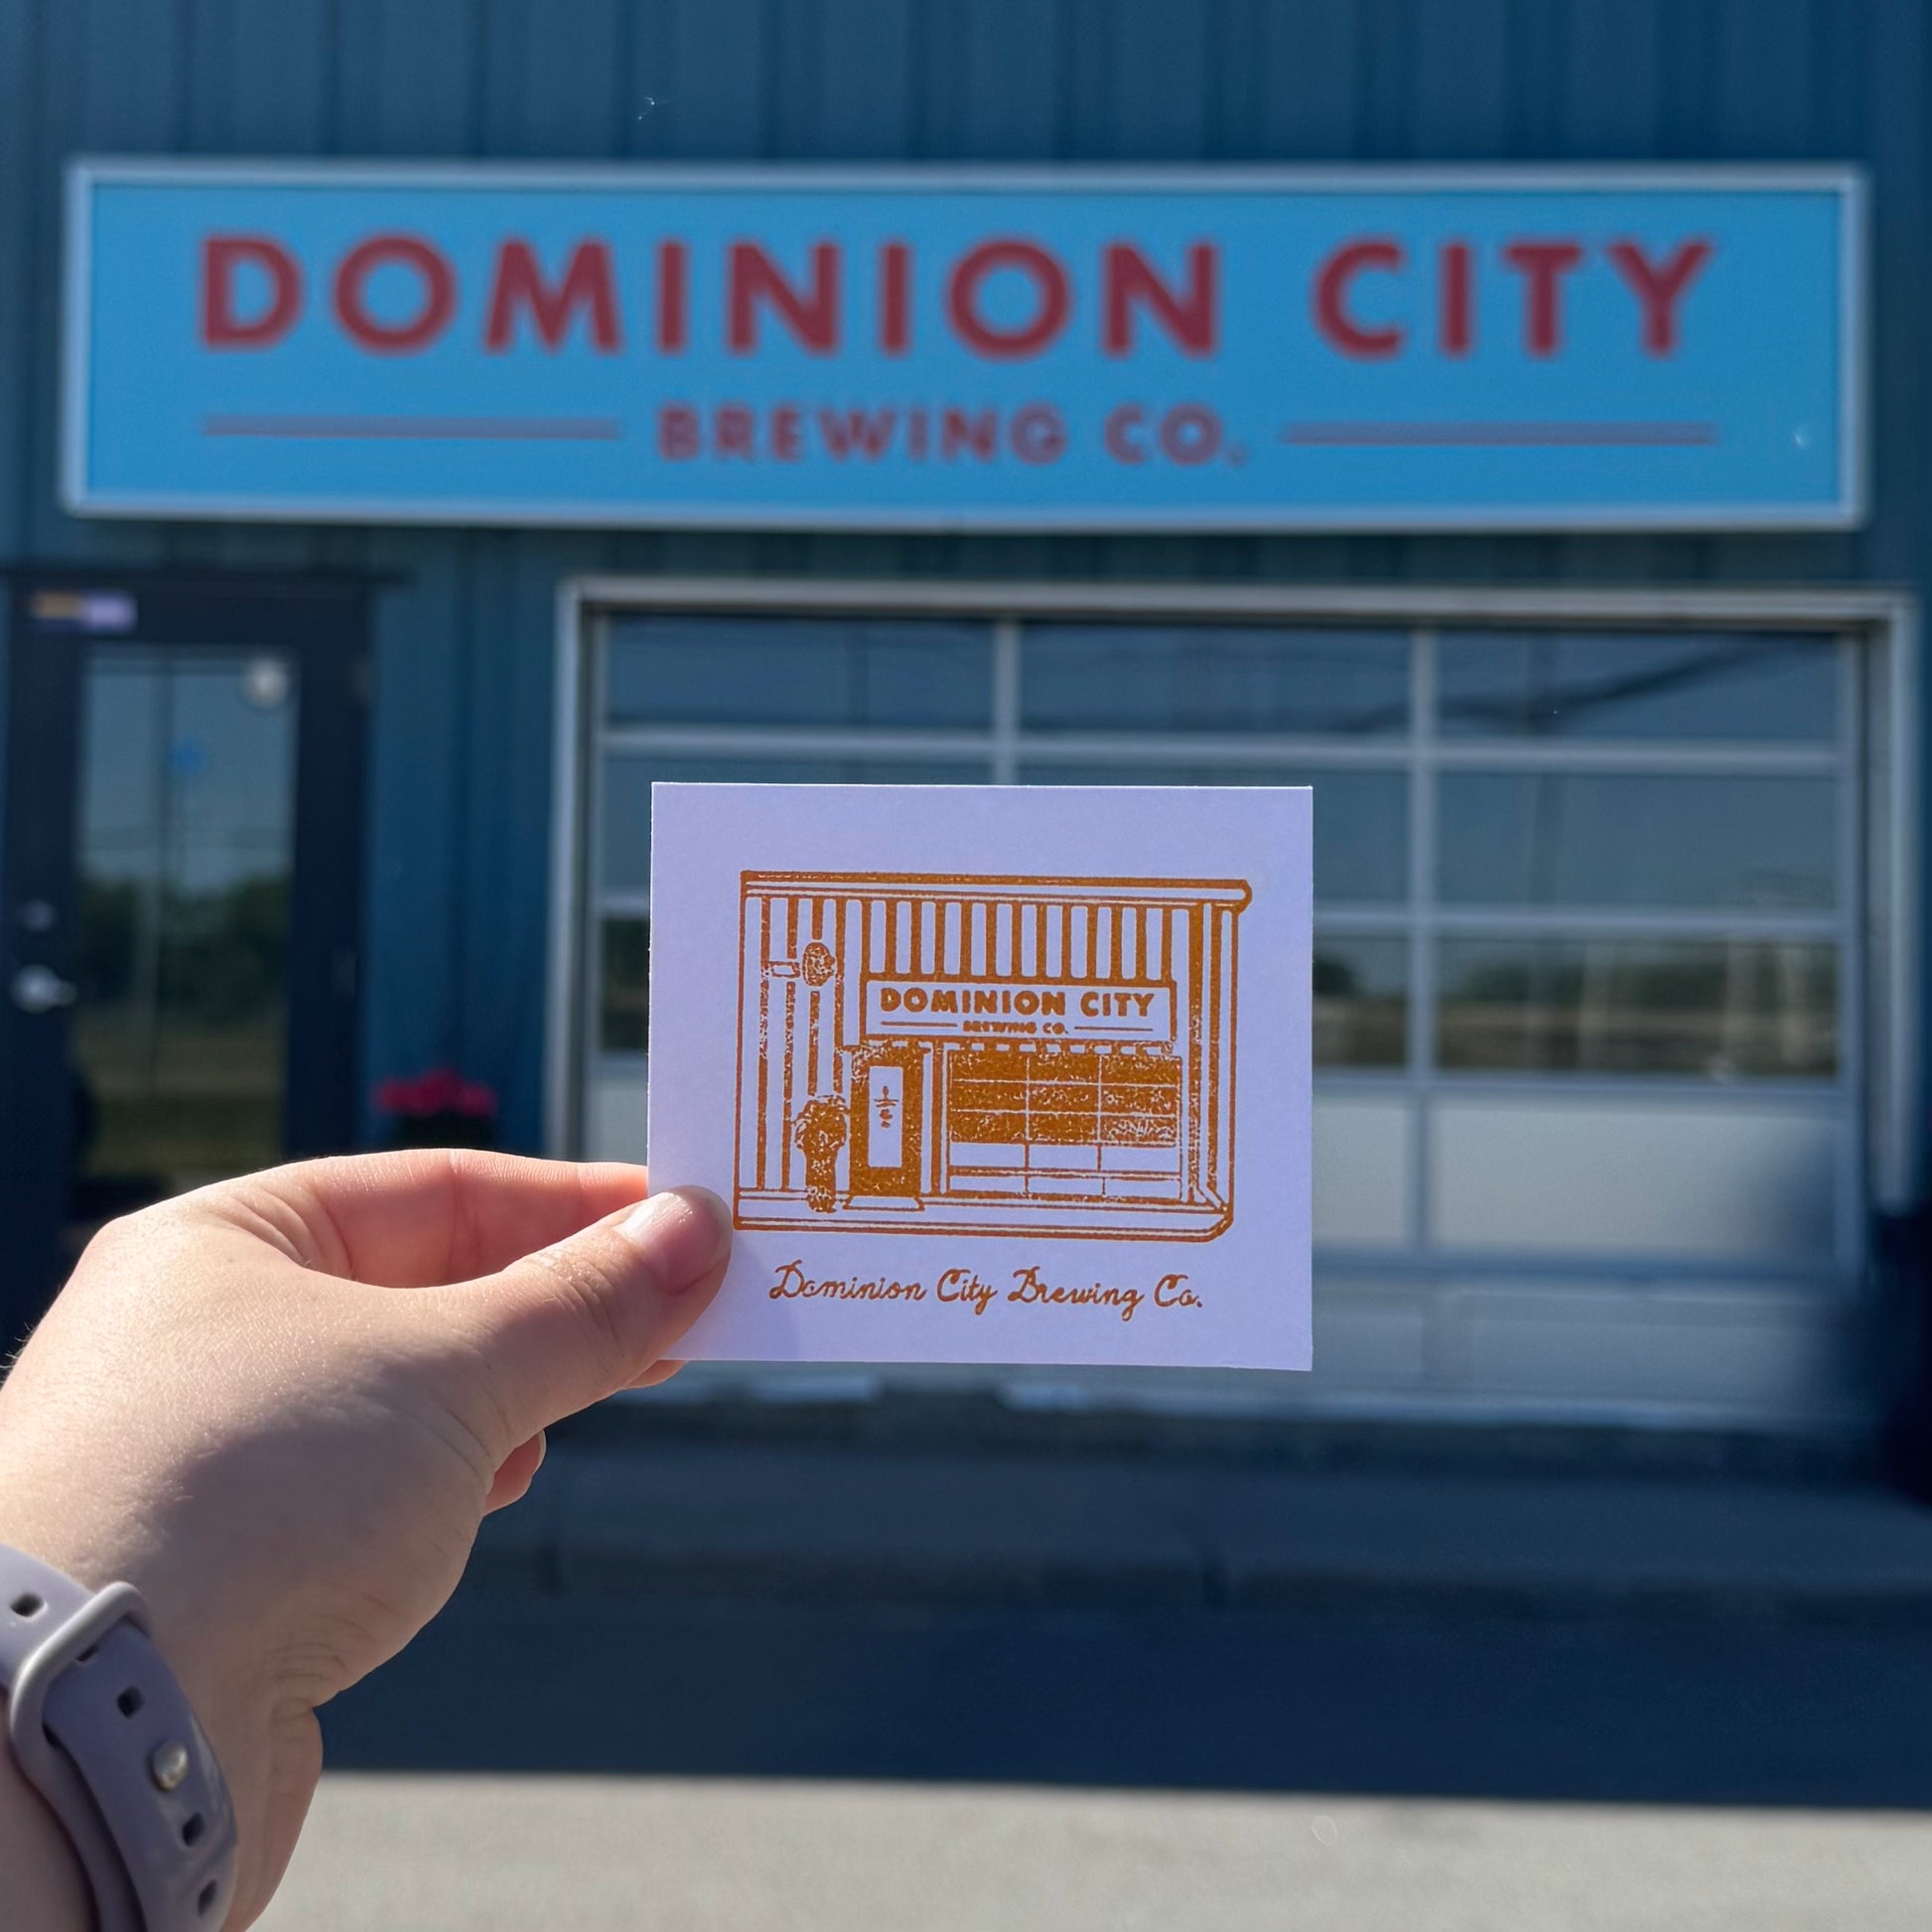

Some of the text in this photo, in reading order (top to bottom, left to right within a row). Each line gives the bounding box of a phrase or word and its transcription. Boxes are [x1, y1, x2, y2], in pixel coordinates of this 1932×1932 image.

[199, 231, 1718, 361] DOMINION CITY
[656, 402, 1250, 468] BREWING CO.
[880, 987, 1155, 1017] DOMINION CITY
[1042, 1022, 1069, 1035] CO.
[768, 1259, 1203, 1321] Dominion City Brewing Co.
